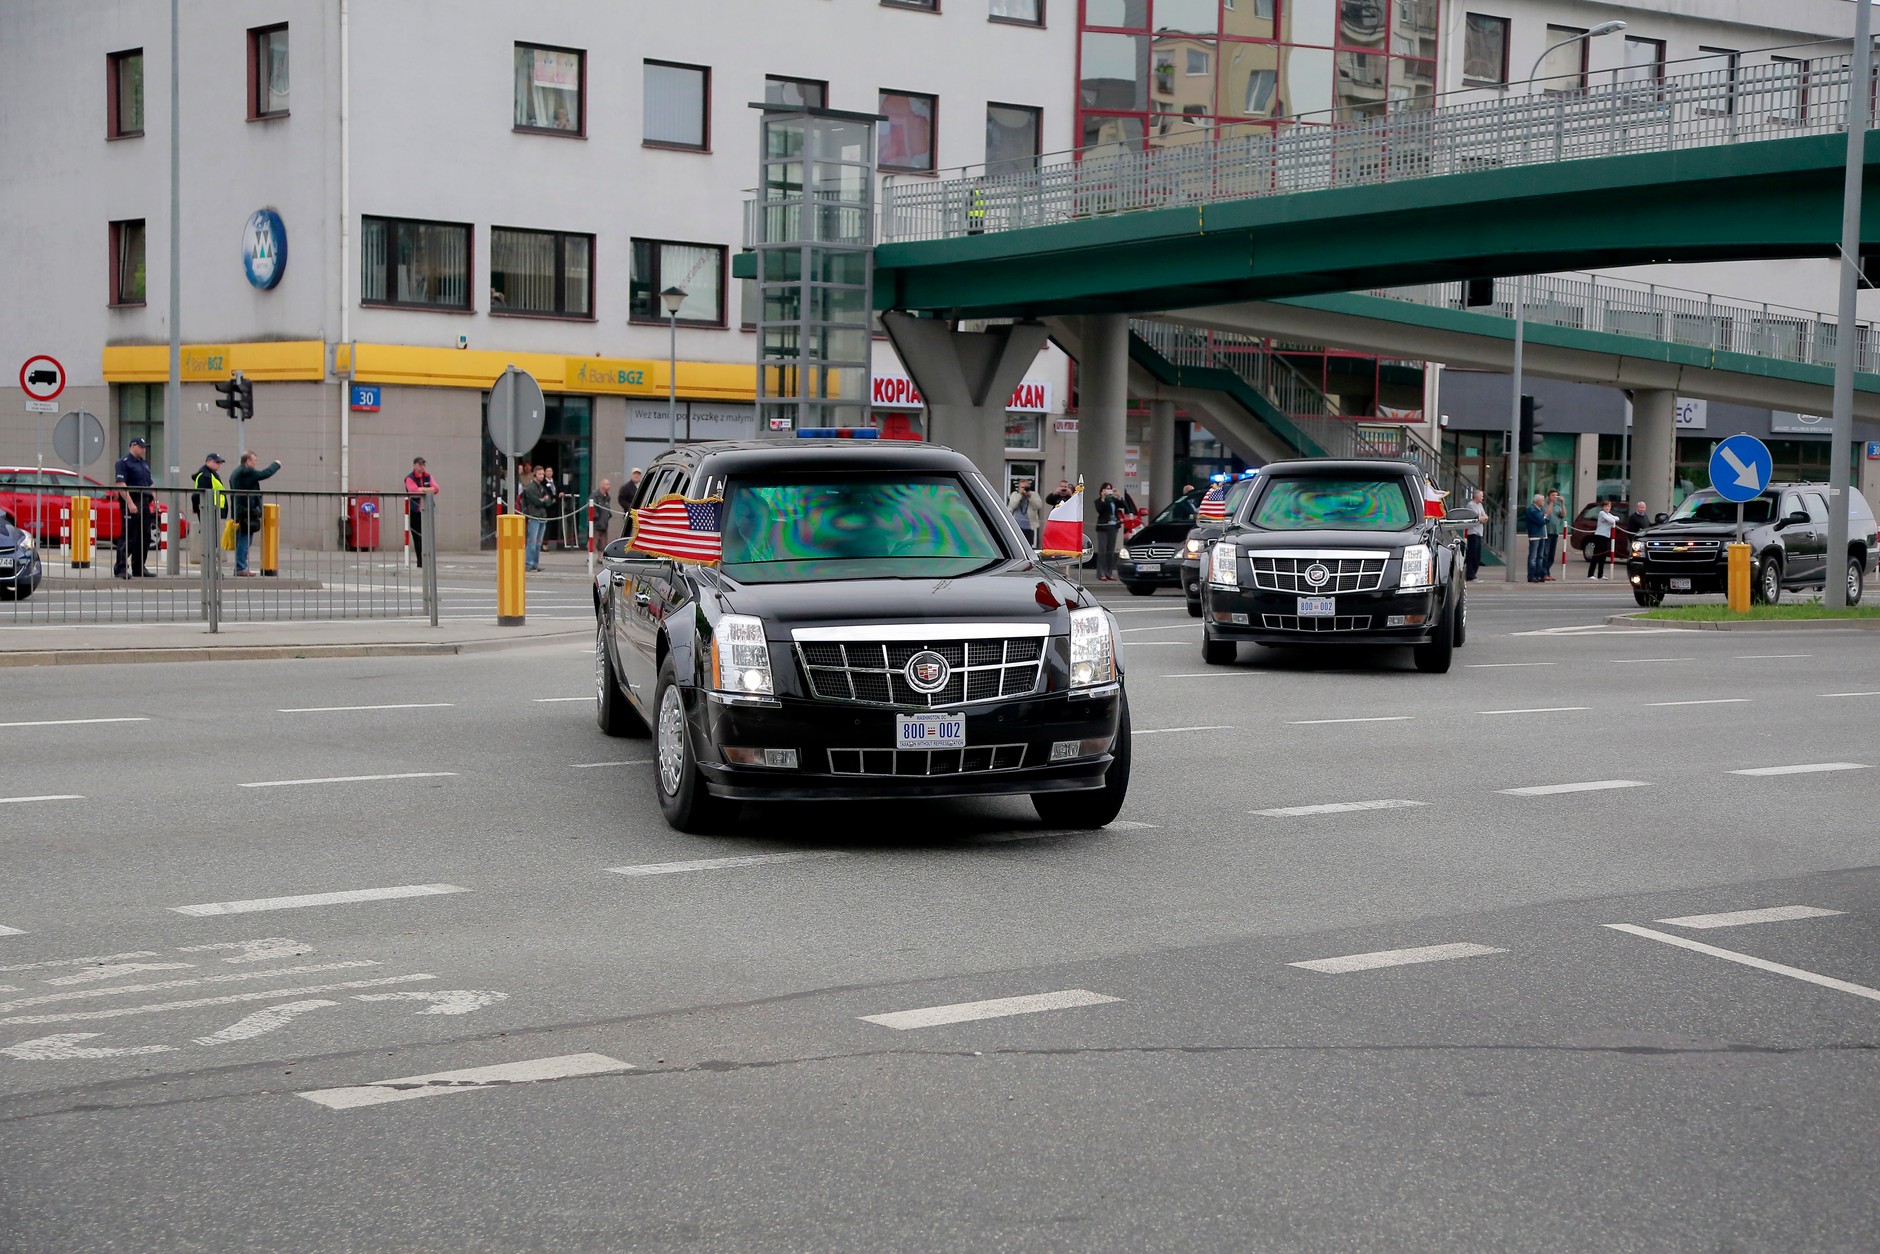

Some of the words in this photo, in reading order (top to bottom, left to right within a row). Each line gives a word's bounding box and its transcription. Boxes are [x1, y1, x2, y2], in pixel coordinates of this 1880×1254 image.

[589, 368, 616, 383] Bank
[359, 391, 374, 405] 30
[1301, 602, 1312, 610] 800
[1321, 602, 1332, 610] 002
[904, 723, 924, 739] 800
[940, 722, 960, 738] 002
